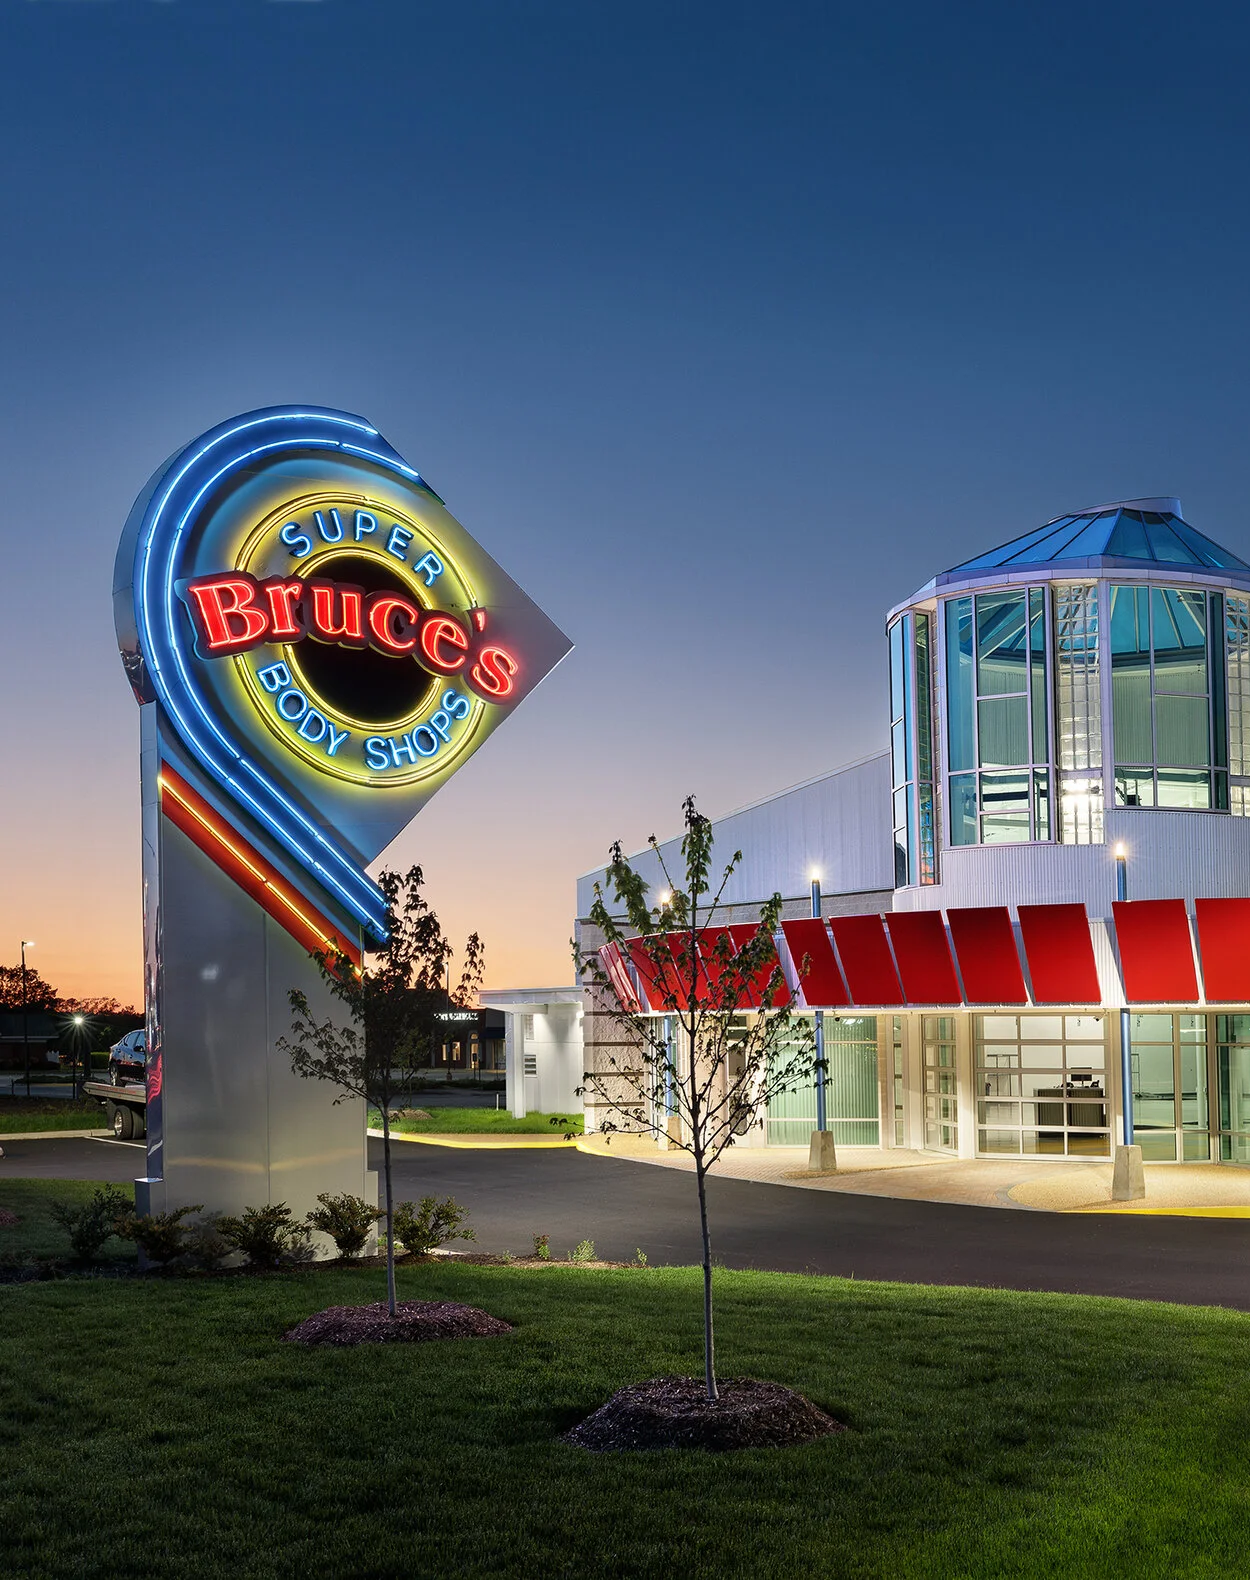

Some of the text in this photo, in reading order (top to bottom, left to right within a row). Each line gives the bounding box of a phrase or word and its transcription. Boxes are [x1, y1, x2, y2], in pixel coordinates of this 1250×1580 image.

[281, 508, 444, 587] SUPER
[188, 578, 519, 697] Bruce's
[256, 660, 471, 772] BODY SHOPS
